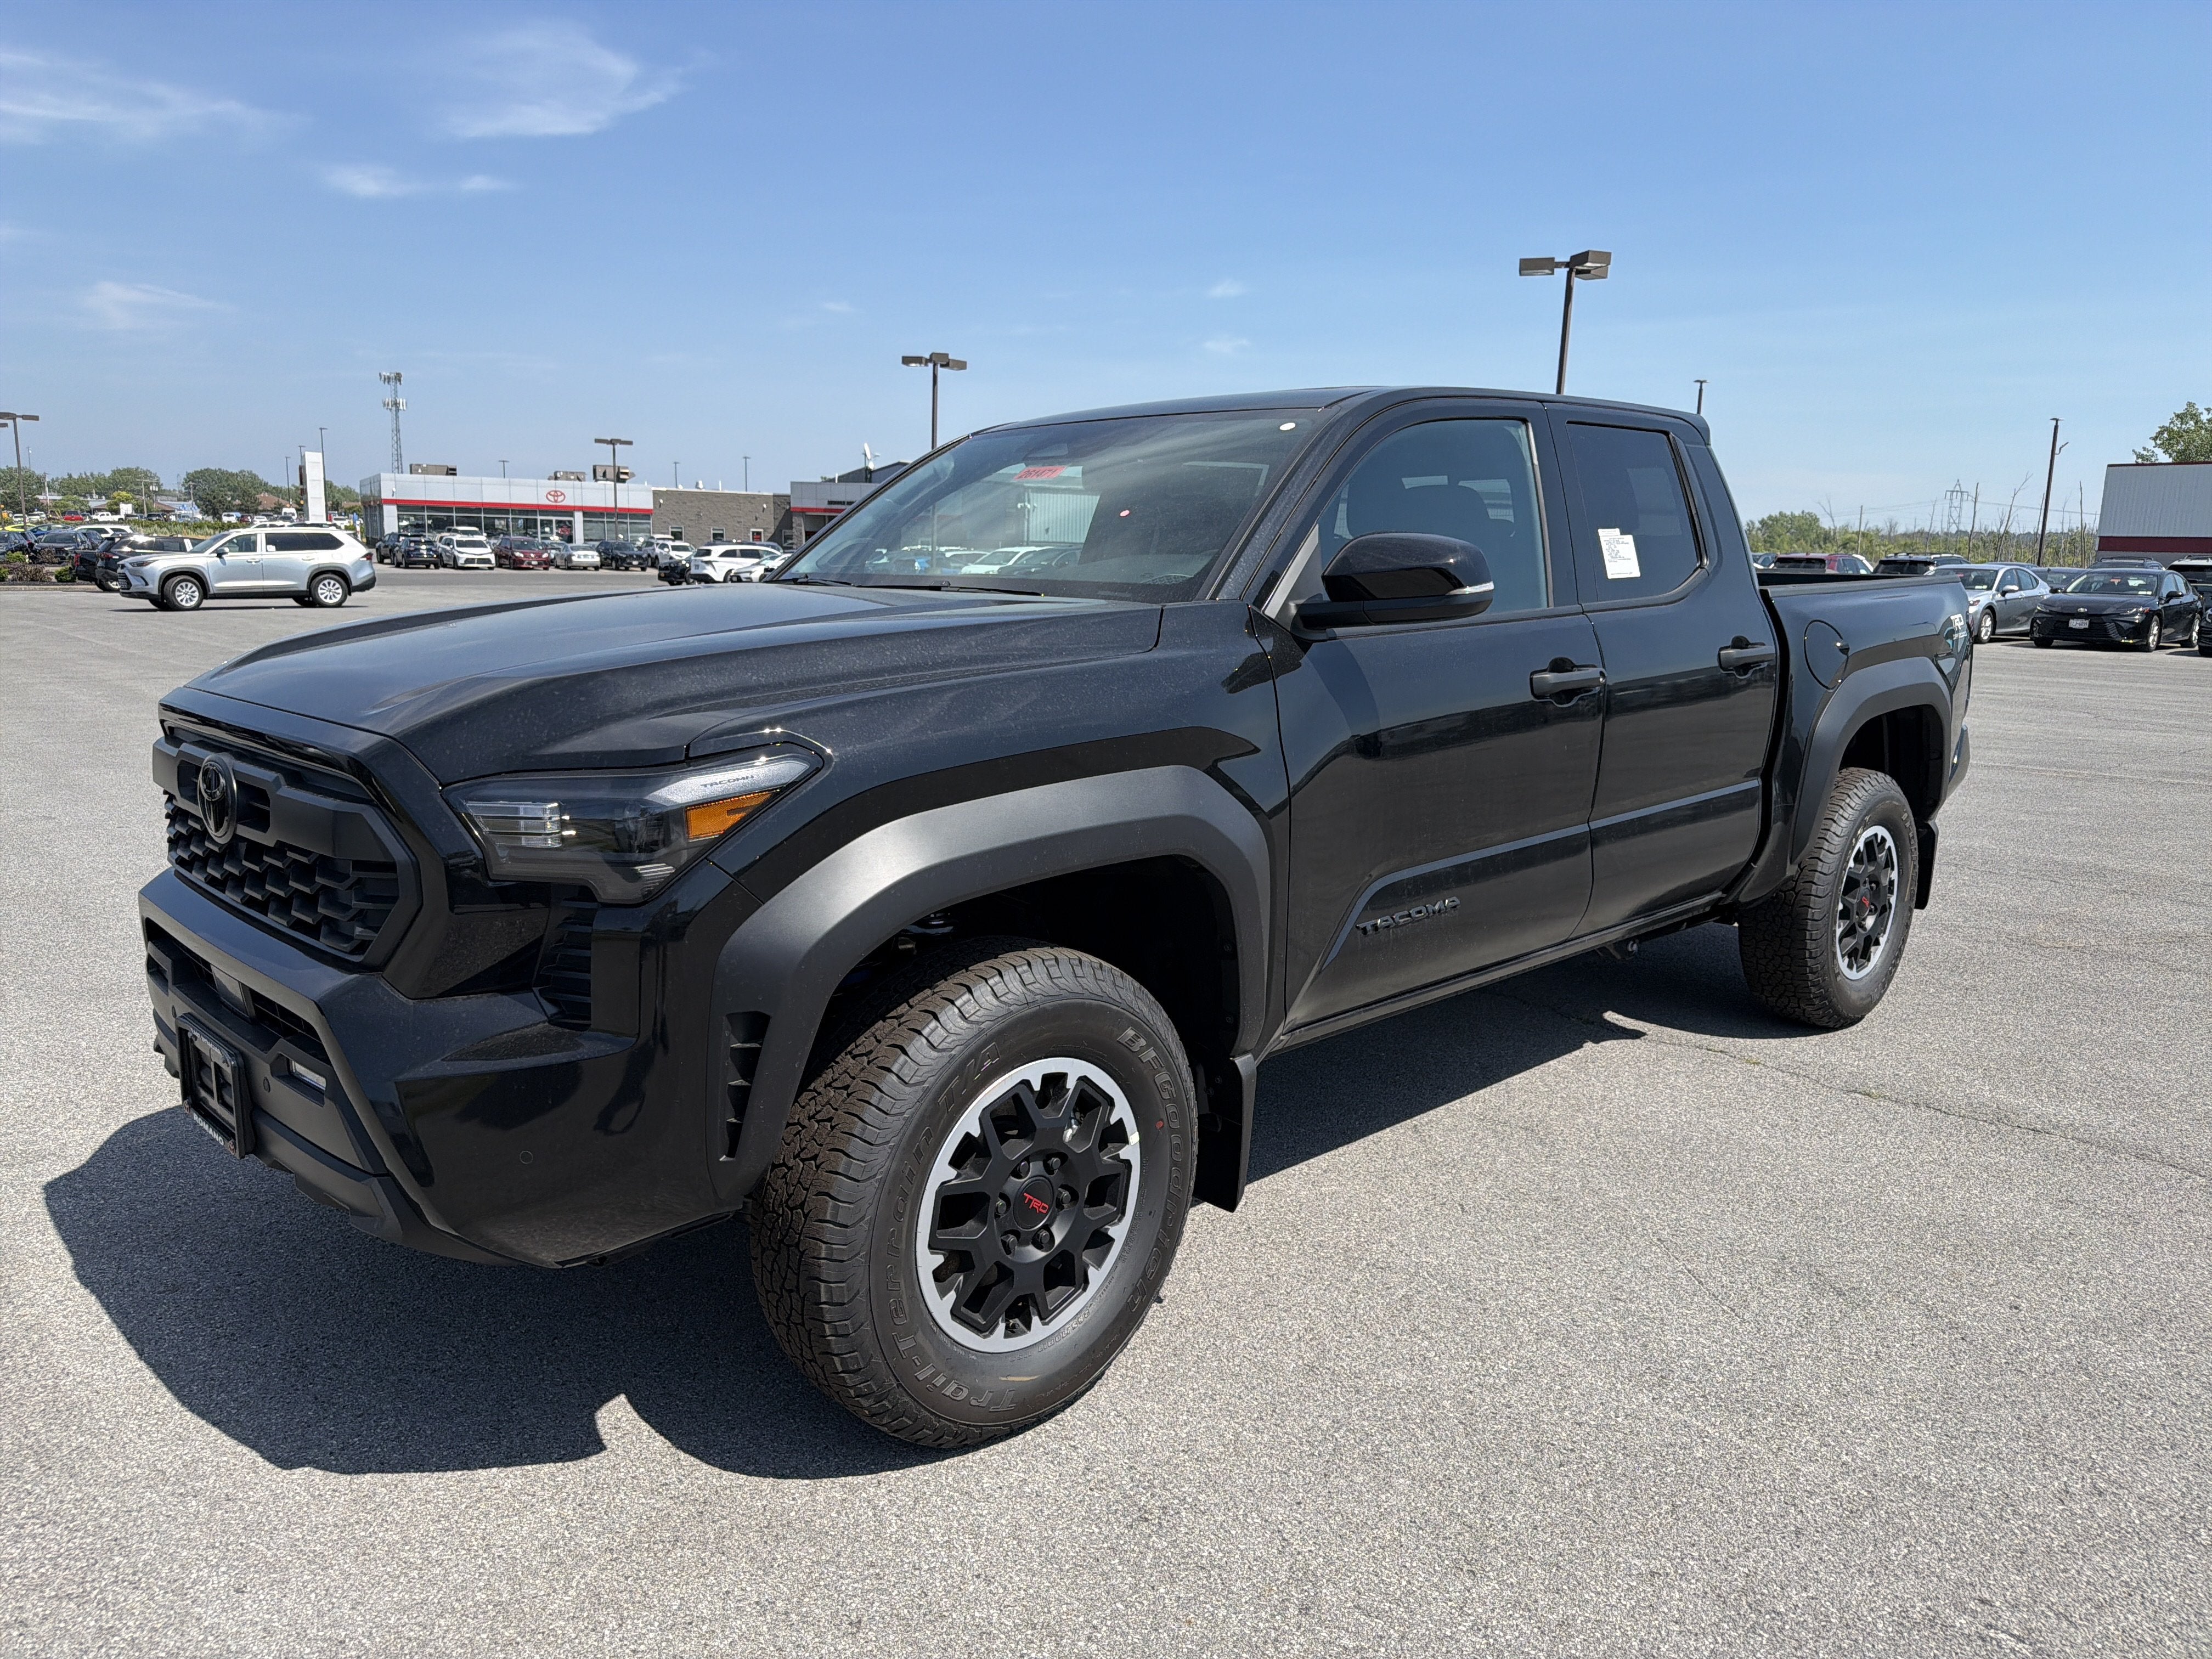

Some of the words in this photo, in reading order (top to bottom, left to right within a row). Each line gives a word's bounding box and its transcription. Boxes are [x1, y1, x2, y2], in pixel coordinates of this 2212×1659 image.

[1950, 614, 1963, 630] TRD
[700, 775, 754, 788] TACOMA
[1356, 896, 1460, 935] TACOMA
[193, 1113, 224, 1146] ROMANO
[1024, 1192, 1049, 1214] TRD
